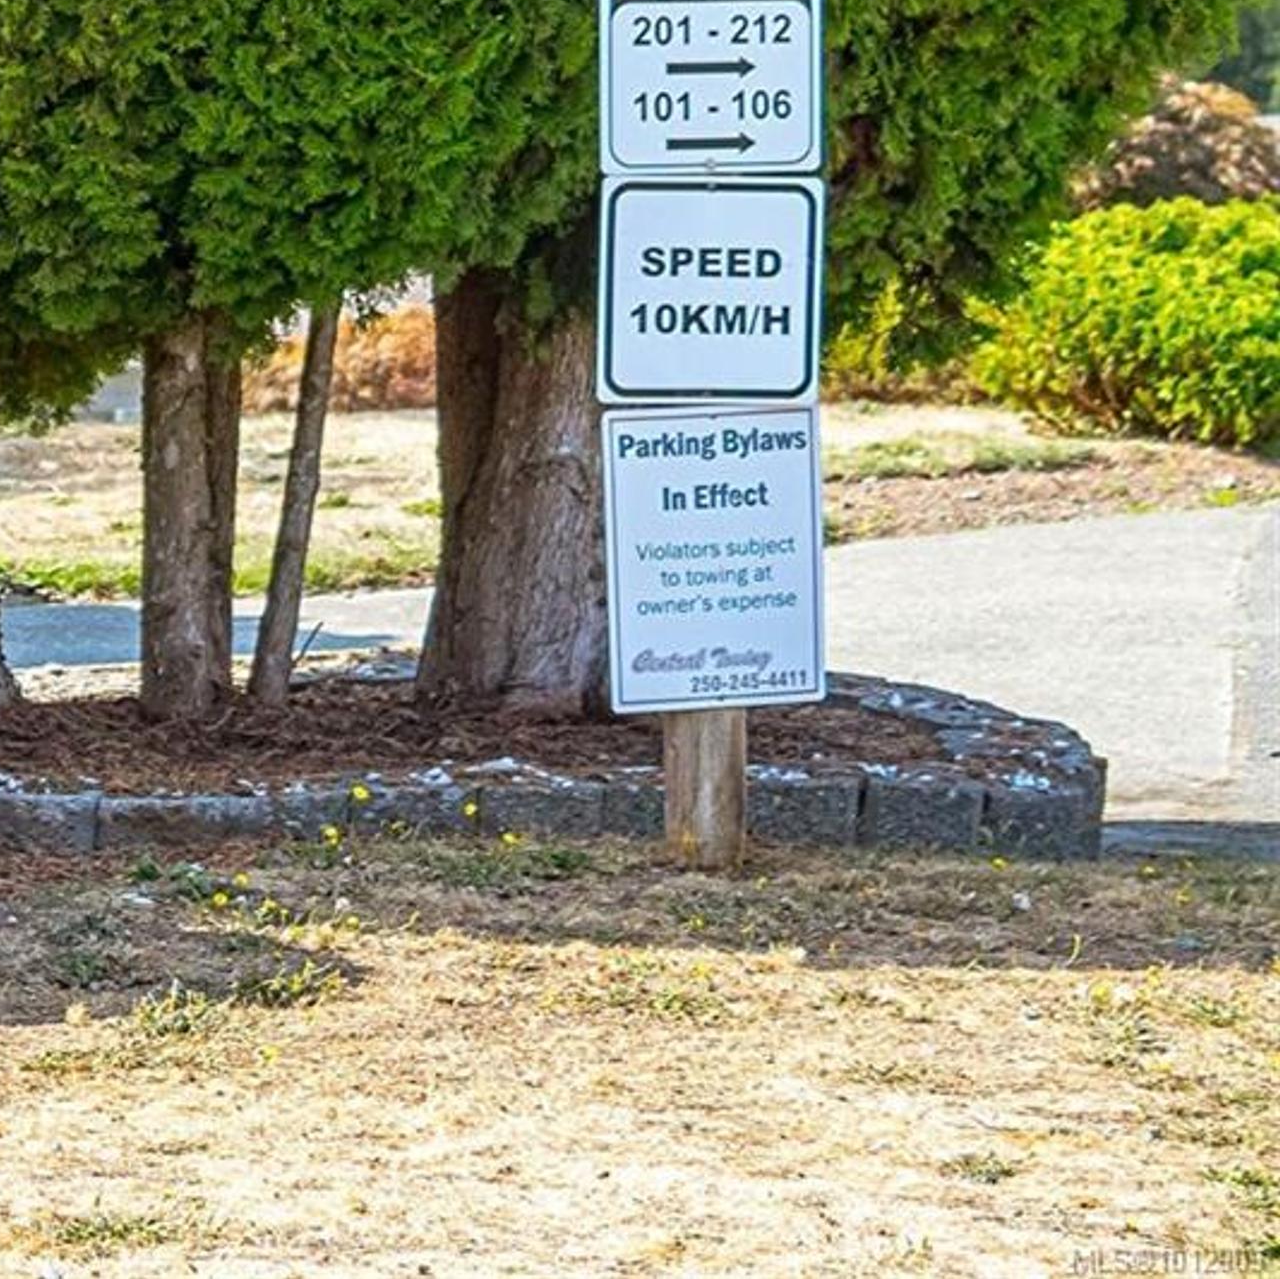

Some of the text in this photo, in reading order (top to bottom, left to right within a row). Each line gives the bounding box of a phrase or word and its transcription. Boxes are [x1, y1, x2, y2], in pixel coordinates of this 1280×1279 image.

[633, 17, 691, 46] 201
[730, 14, 791, 44] 212
[634, 93, 691, 122] 101
[731, 90, 792, 119] 106
[641, 247, 783, 277] SPEED
[630, 303, 790, 335] 10KM/H
[618, 428, 807, 460] Parking Bylaws
[662, 482, 769, 511] In Effect
[635, 536, 796, 561] Violators subject
[661, 564, 774, 588] to towing at
[636, 591, 797, 616] owner's expense
[690, 670, 808, 694] 250-245-4411
